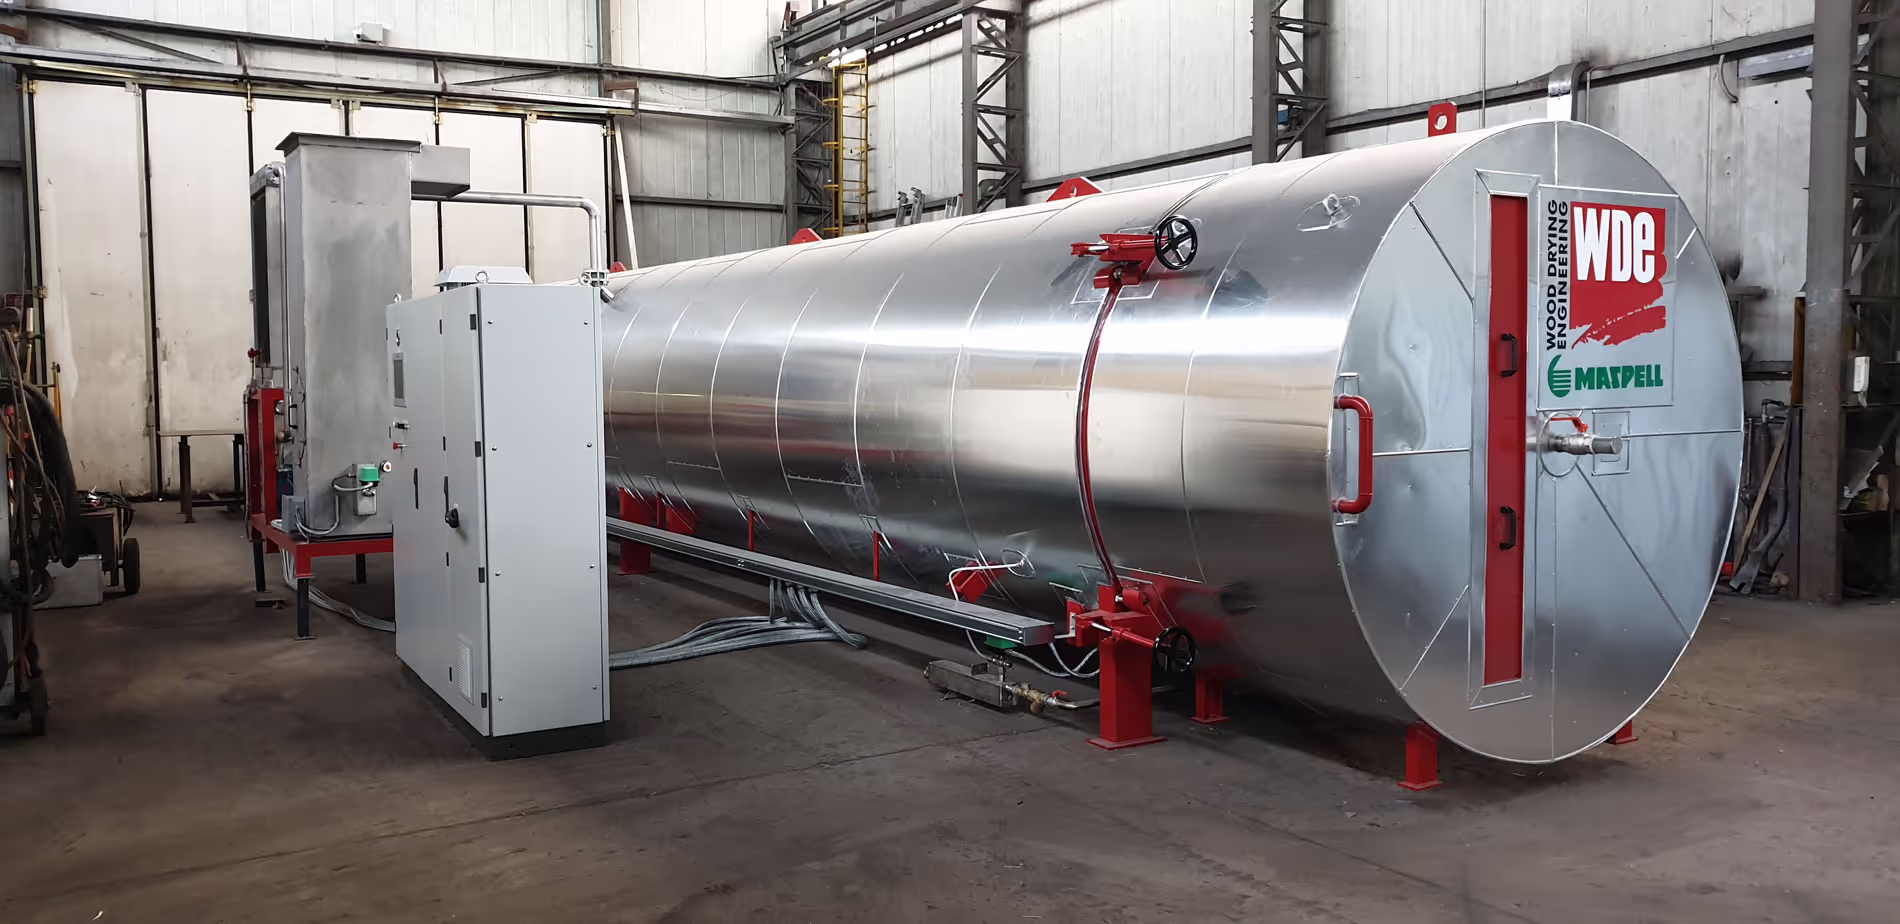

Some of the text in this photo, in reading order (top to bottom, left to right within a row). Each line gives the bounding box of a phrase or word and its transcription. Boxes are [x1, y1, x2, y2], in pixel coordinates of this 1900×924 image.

[1547, 199, 1558, 350] WOOD DRYING
[1557, 200, 1568, 350] ENGINEERING
[1575, 364, 1664, 391] MASPELL
